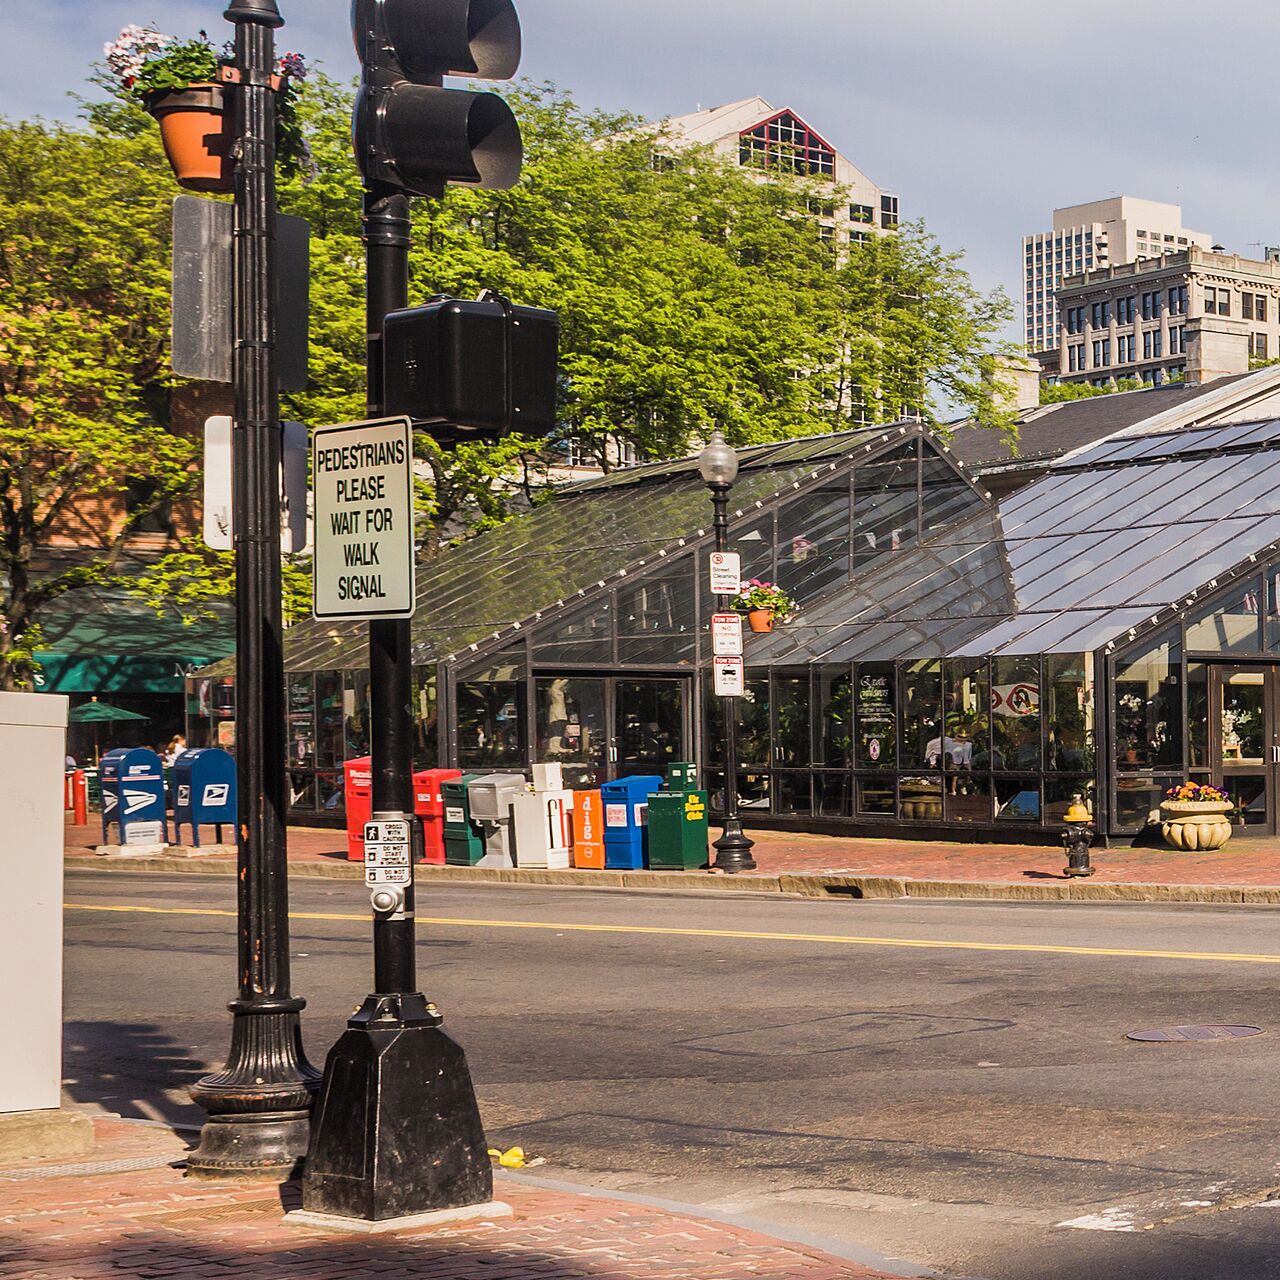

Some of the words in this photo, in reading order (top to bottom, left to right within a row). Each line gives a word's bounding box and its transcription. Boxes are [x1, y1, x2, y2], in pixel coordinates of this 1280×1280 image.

[318, 440, 405, 473] PEDESTRIANS
[337, 475, 385, 503] PLEASE
[330, 510, 361, 536] WAIT
[366, 508, 393, 533] FOR
[343, 542, 380, 567] WALK
[338, 574, 386, 601] SIGNAL
[582, 796, 593, 840] dig
